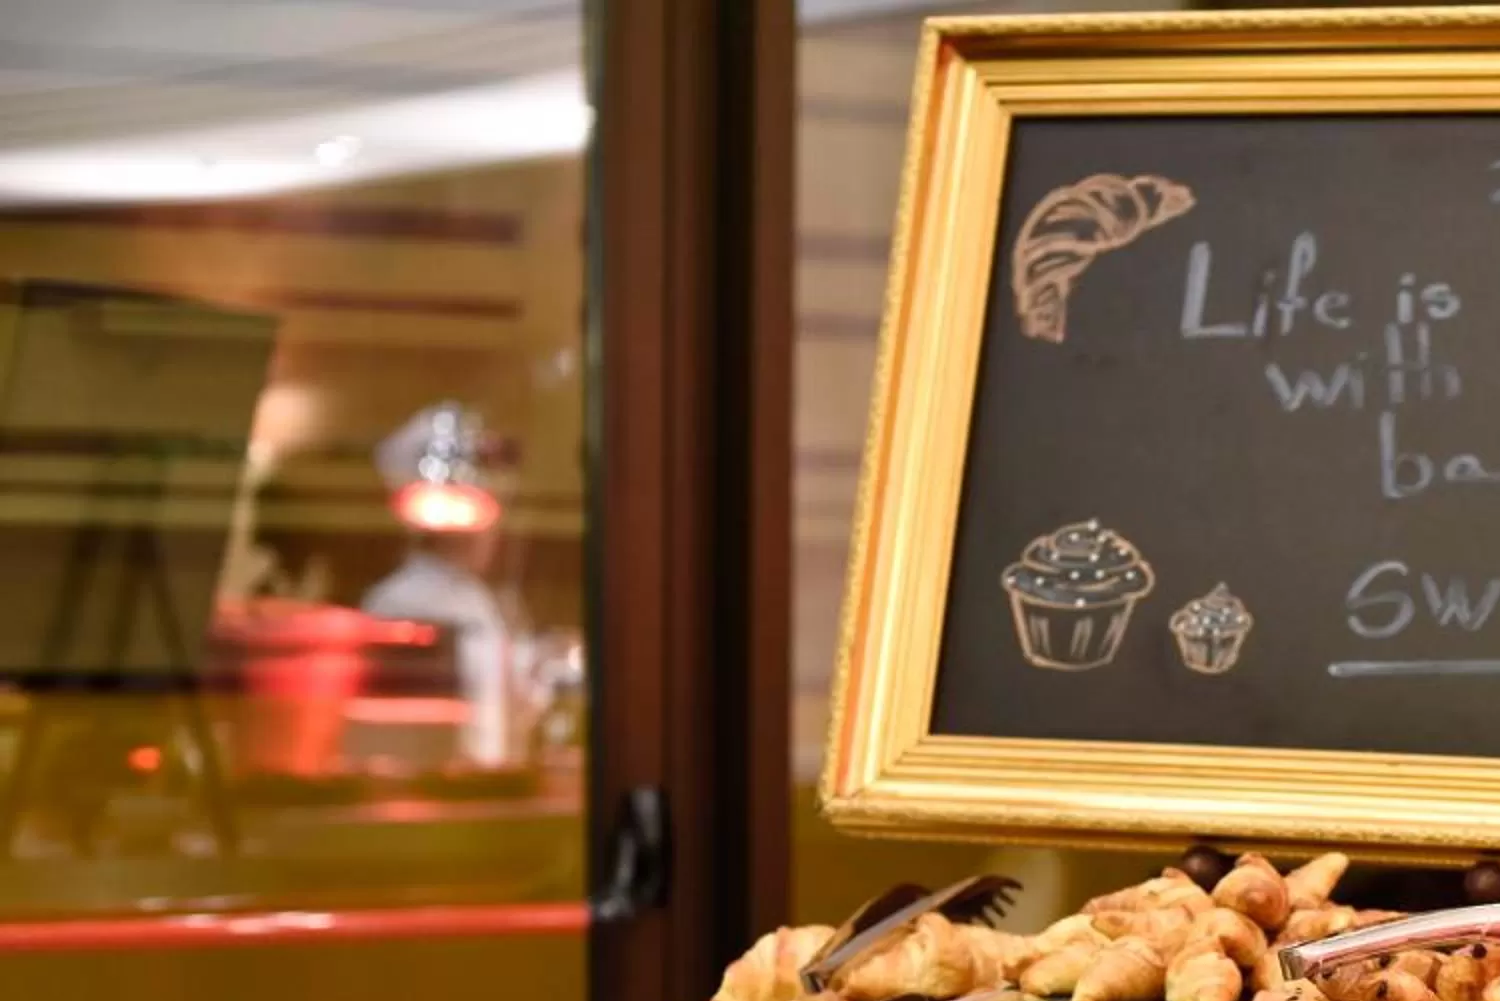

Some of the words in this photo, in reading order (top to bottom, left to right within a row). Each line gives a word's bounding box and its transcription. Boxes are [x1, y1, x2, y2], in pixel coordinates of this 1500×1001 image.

[1180, 231, 1354, 338] Life
[1396, 273, 1461, 324] is
[1265, 322, 1462, 412] with
